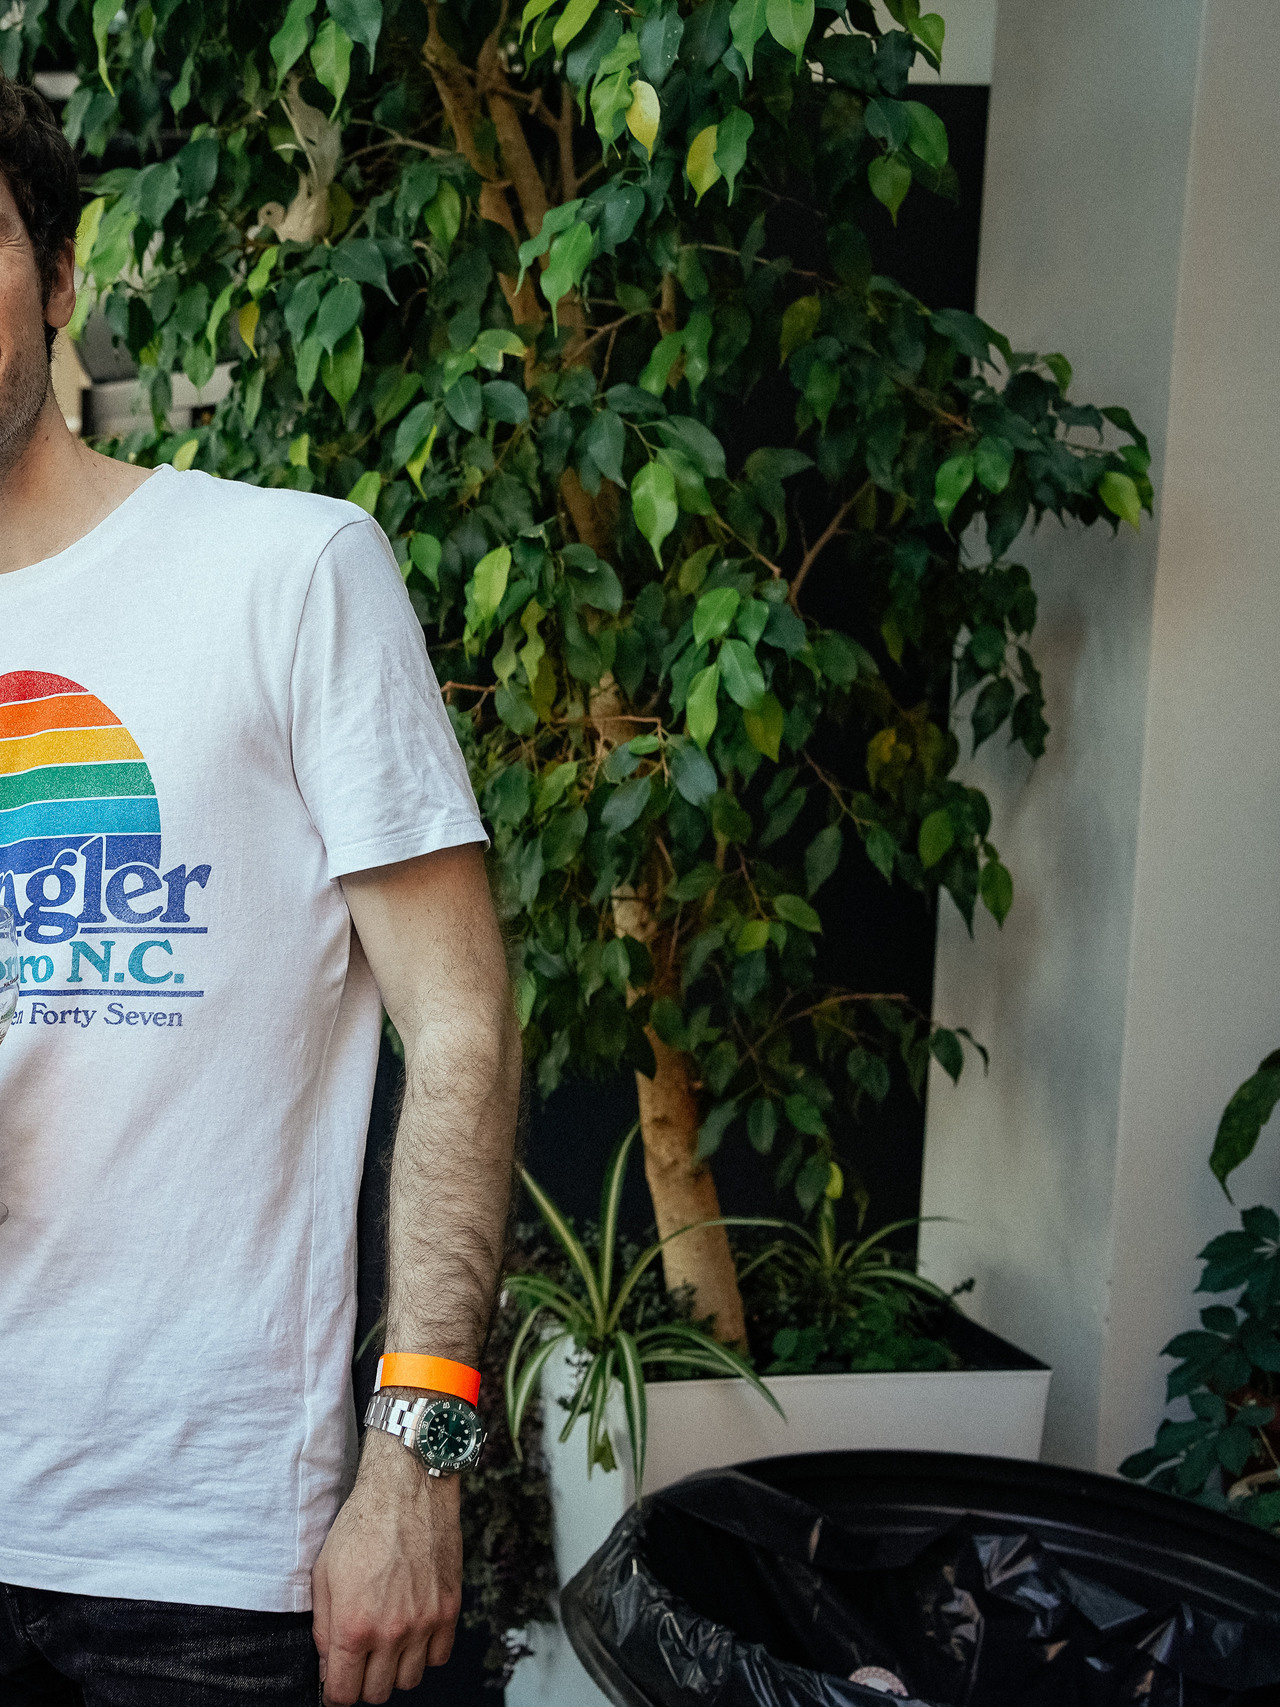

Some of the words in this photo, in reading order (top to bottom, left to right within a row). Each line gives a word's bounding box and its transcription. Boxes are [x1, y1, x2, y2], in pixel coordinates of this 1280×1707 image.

[67, 938, 184, 985] N.C.
[29, 1002, 98, 1028] Forty
[104, 1003, 183, 1027] Seven
